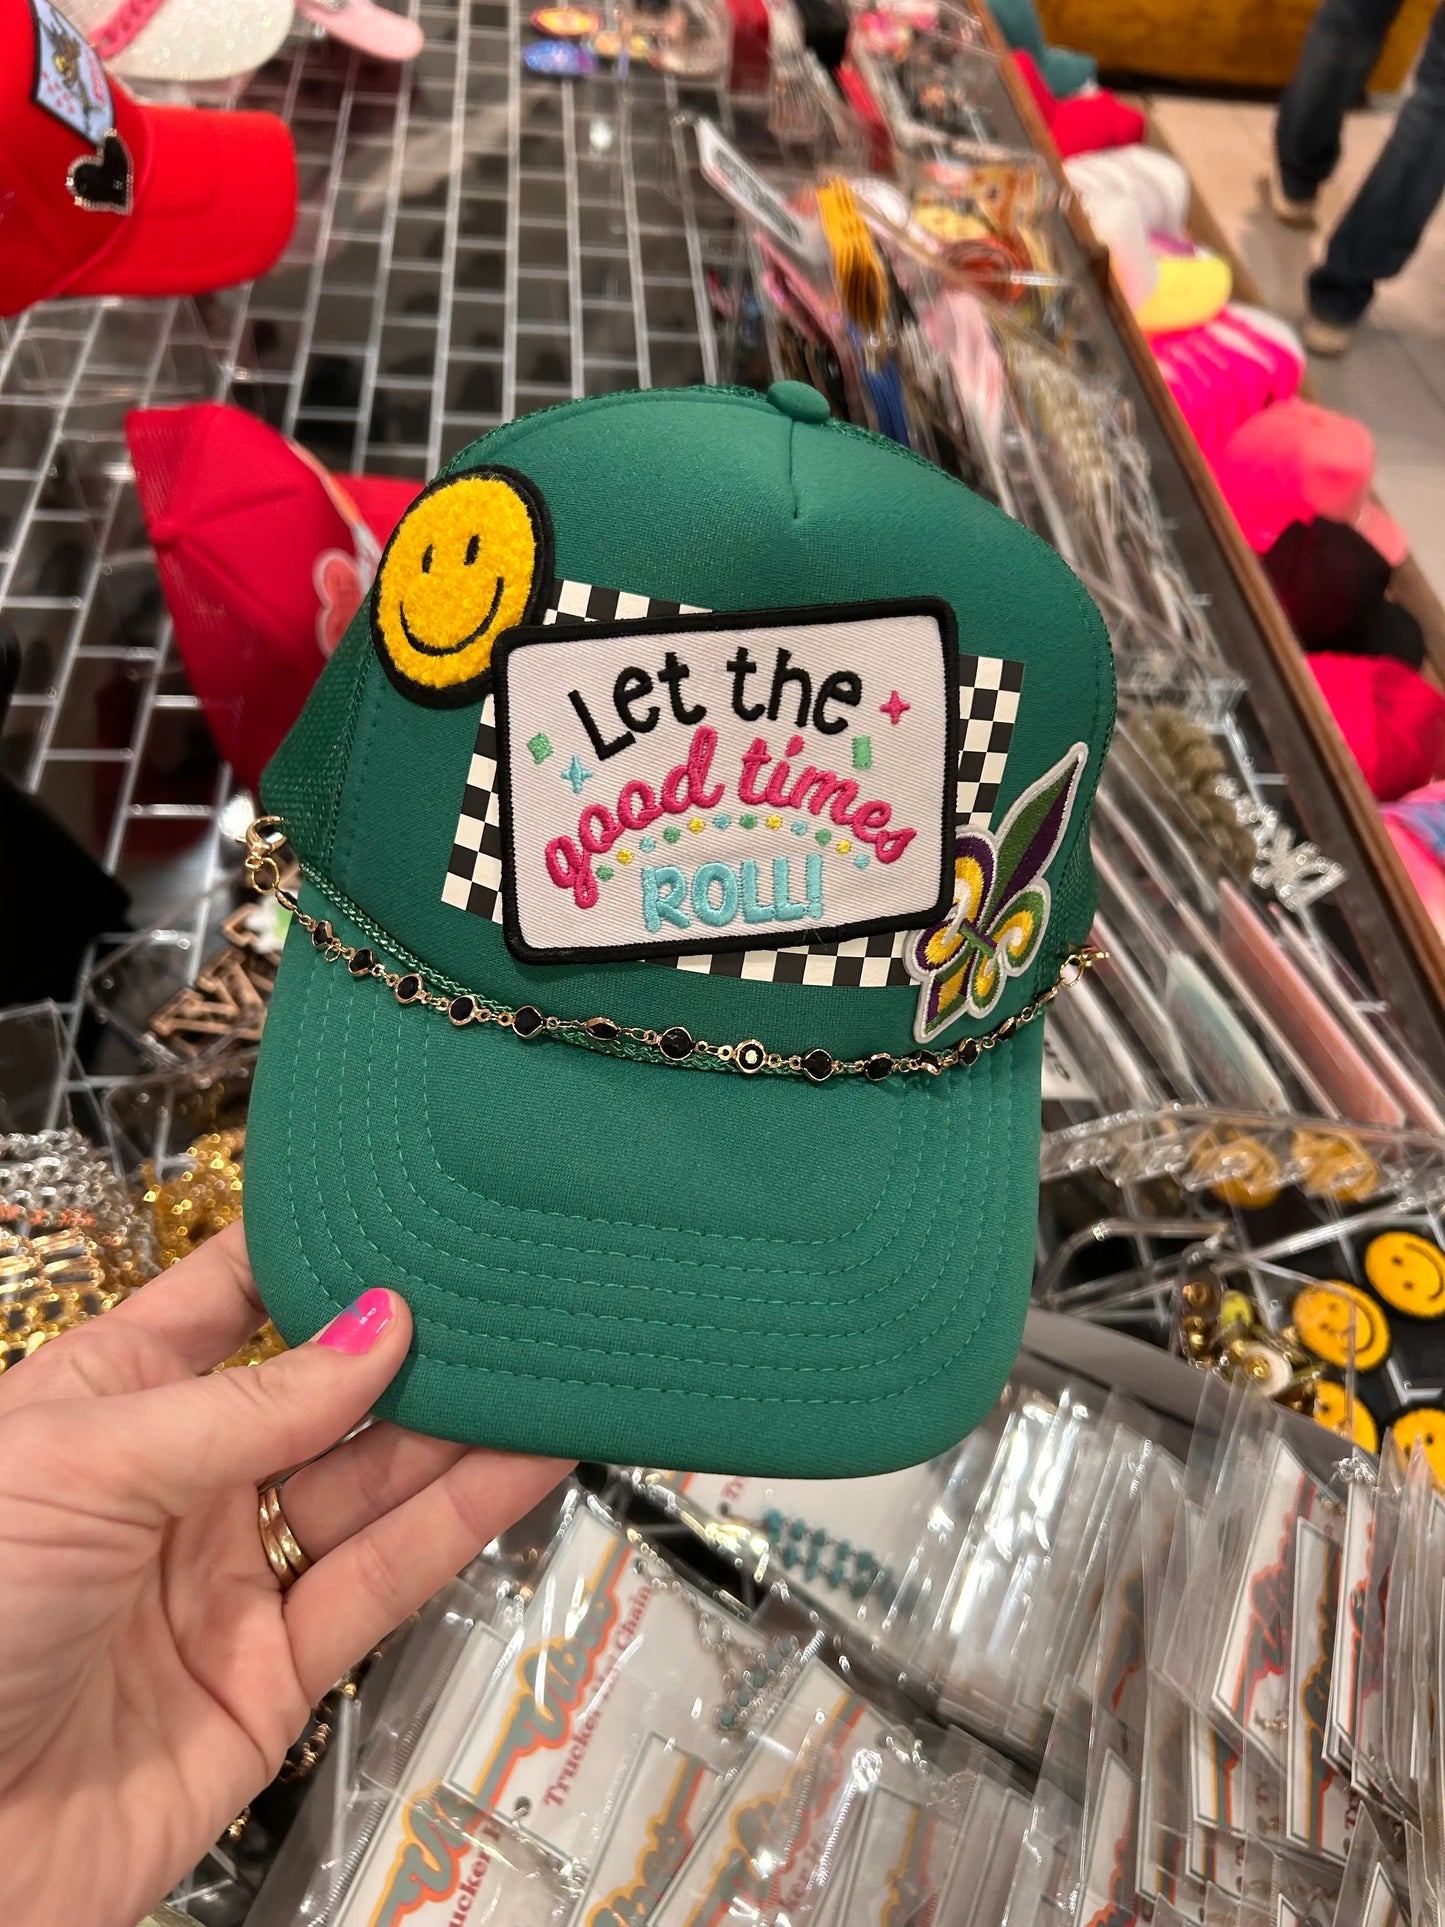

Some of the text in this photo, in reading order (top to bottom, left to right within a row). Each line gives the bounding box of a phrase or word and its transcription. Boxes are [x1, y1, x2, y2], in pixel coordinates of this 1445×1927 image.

[568, 646, 863, 761] Let the
[545, 726, 918, 909] good times
[641, 853, 824, 933] ROLL!
[610, 1582, 652, 1652] Chain
[449, 1848, 493, 1927] ucker
